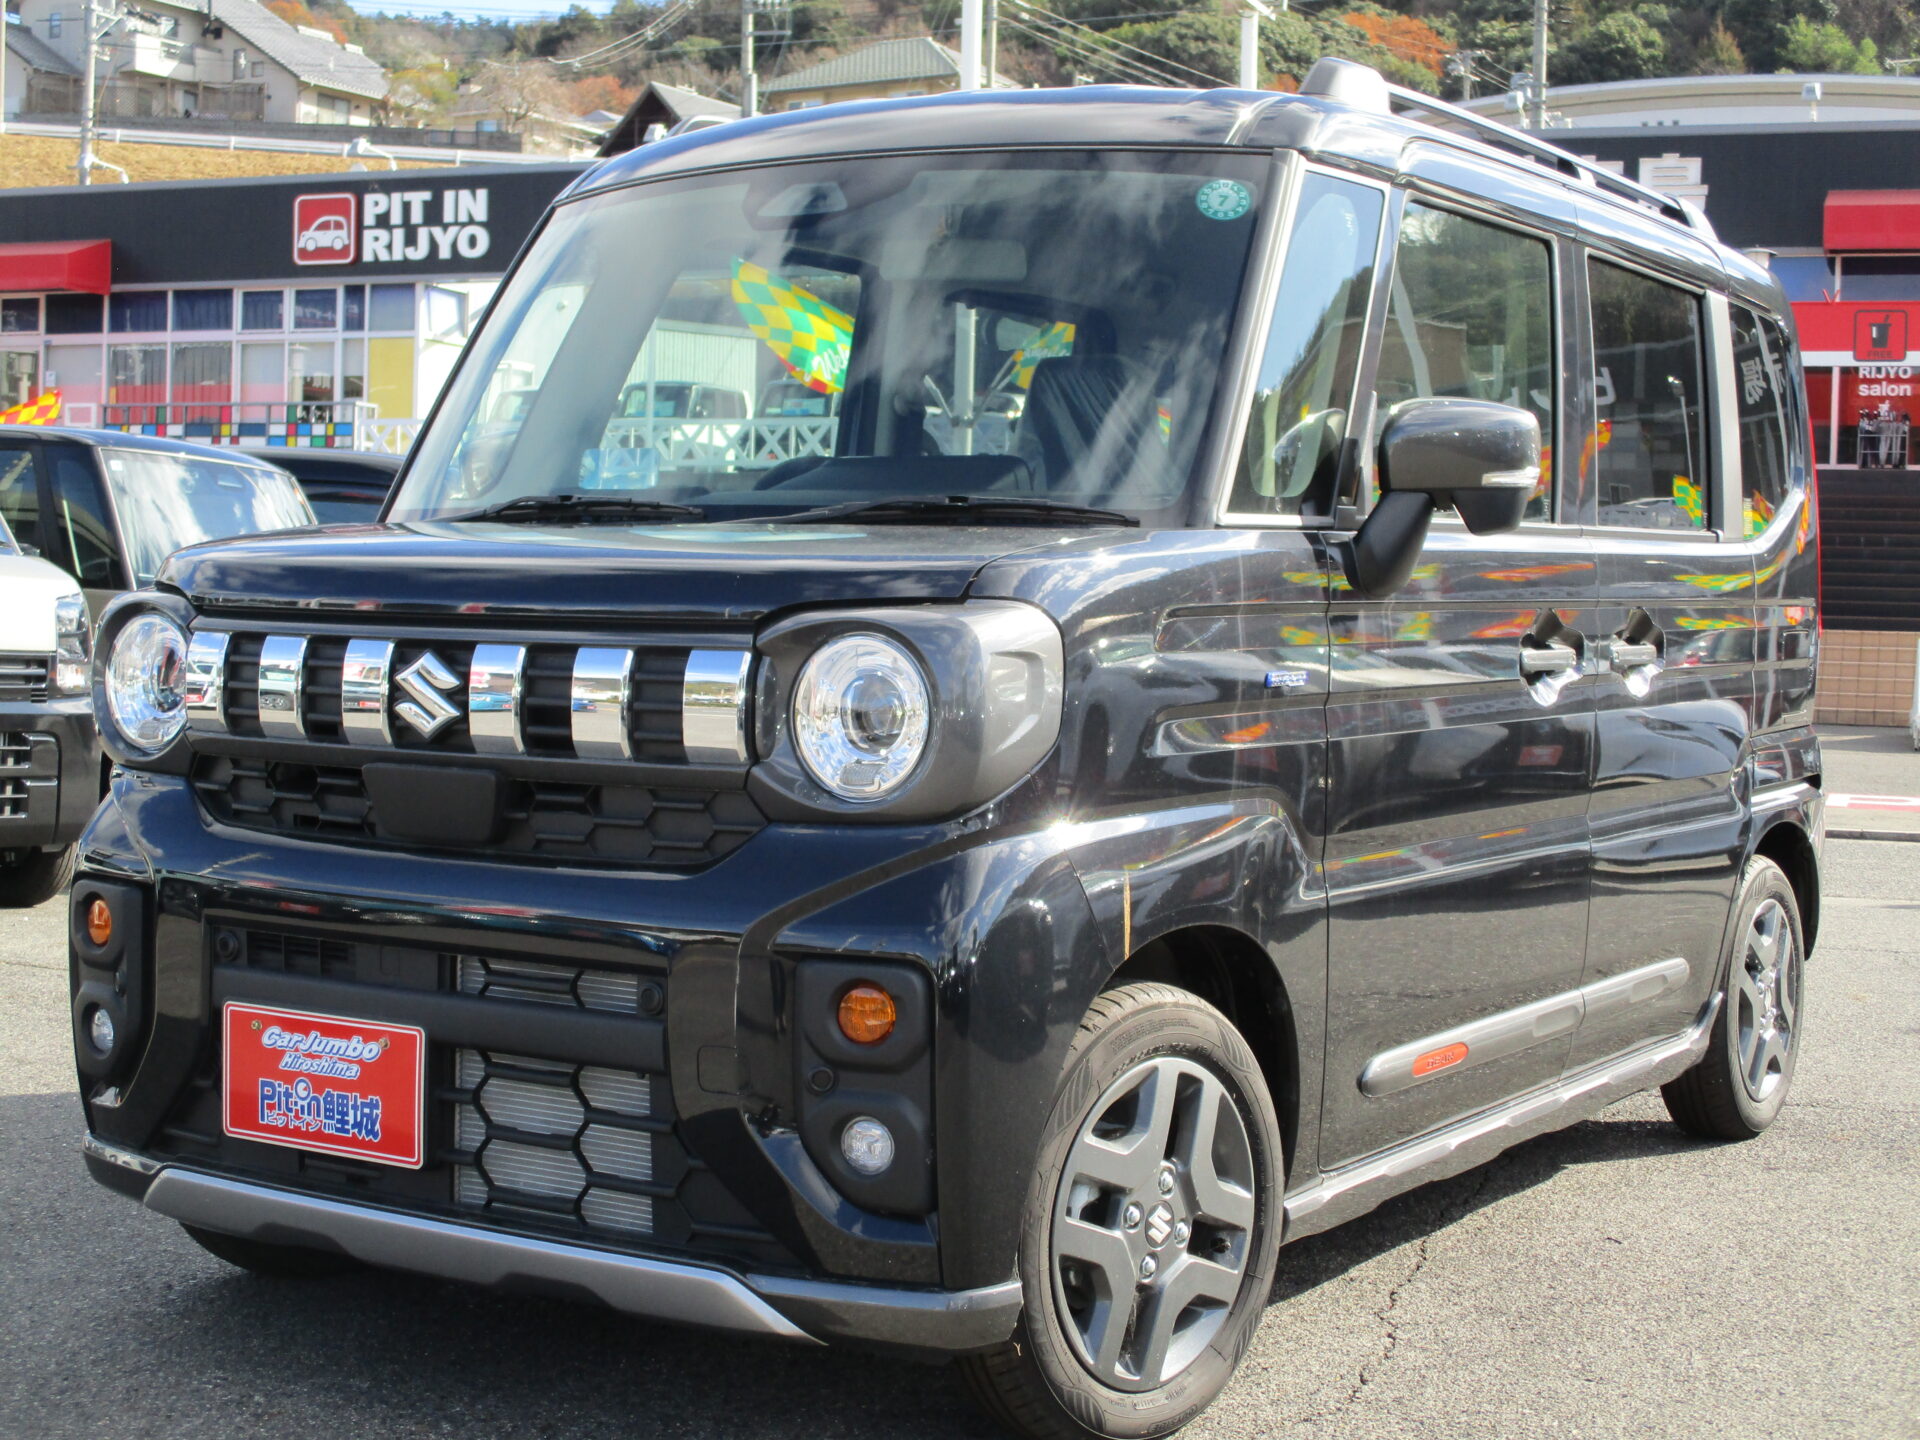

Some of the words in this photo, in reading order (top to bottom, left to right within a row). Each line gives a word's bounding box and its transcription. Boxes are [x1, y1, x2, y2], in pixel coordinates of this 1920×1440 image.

[363, 191, 432, 227] PIT
[443, 188, 489, 223] IN
[1218, 194, 1230, 207] 7
[362, 225, 490, 263] RIJYO
[1859, 367, 1912, 379] RIJYO
[1858, 382, 1912, 396] salon
[279, 1052, 360, 1080] Hiroshima
